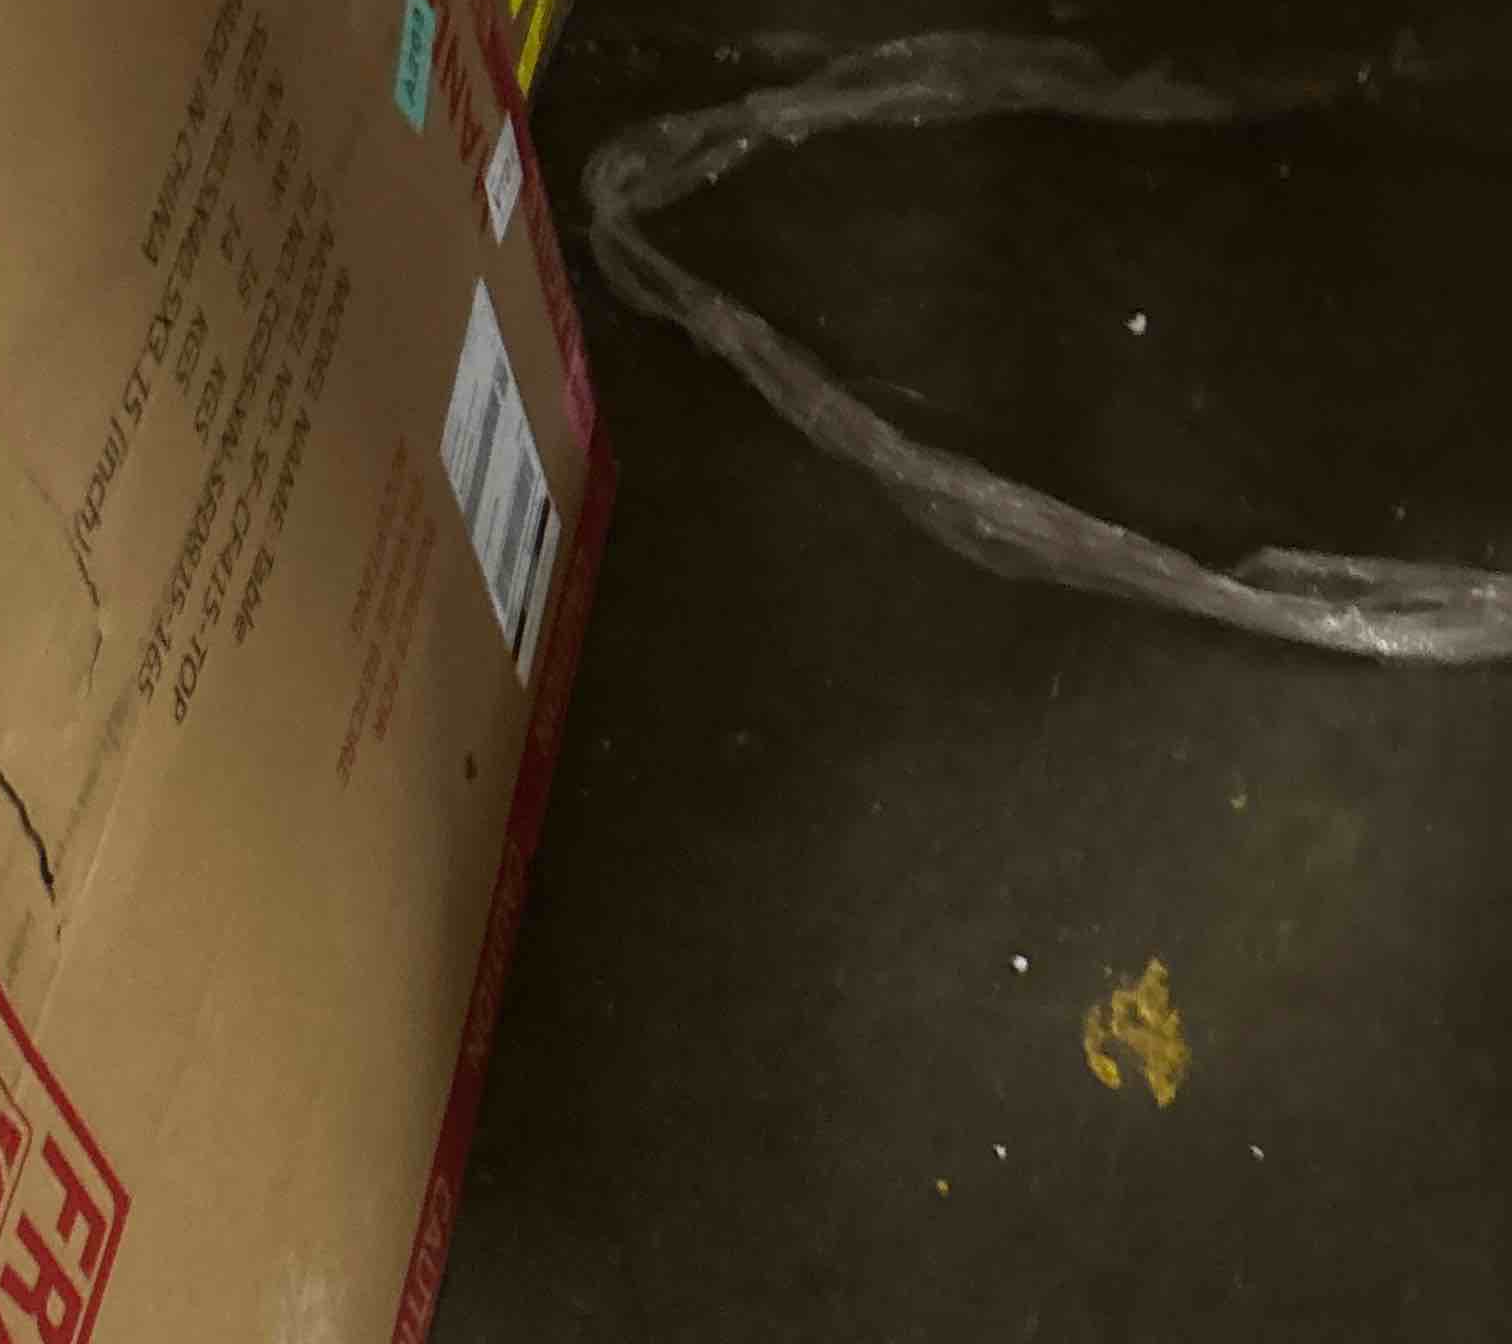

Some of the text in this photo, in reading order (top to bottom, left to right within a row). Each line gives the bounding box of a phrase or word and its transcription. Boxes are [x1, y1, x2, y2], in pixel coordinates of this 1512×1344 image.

[142, 127, 192, 267] CHINA
[176, 304, 209, 398] KGS
[193, 356, 227, 448] KGS
[231, 546, 276, 648] Table
